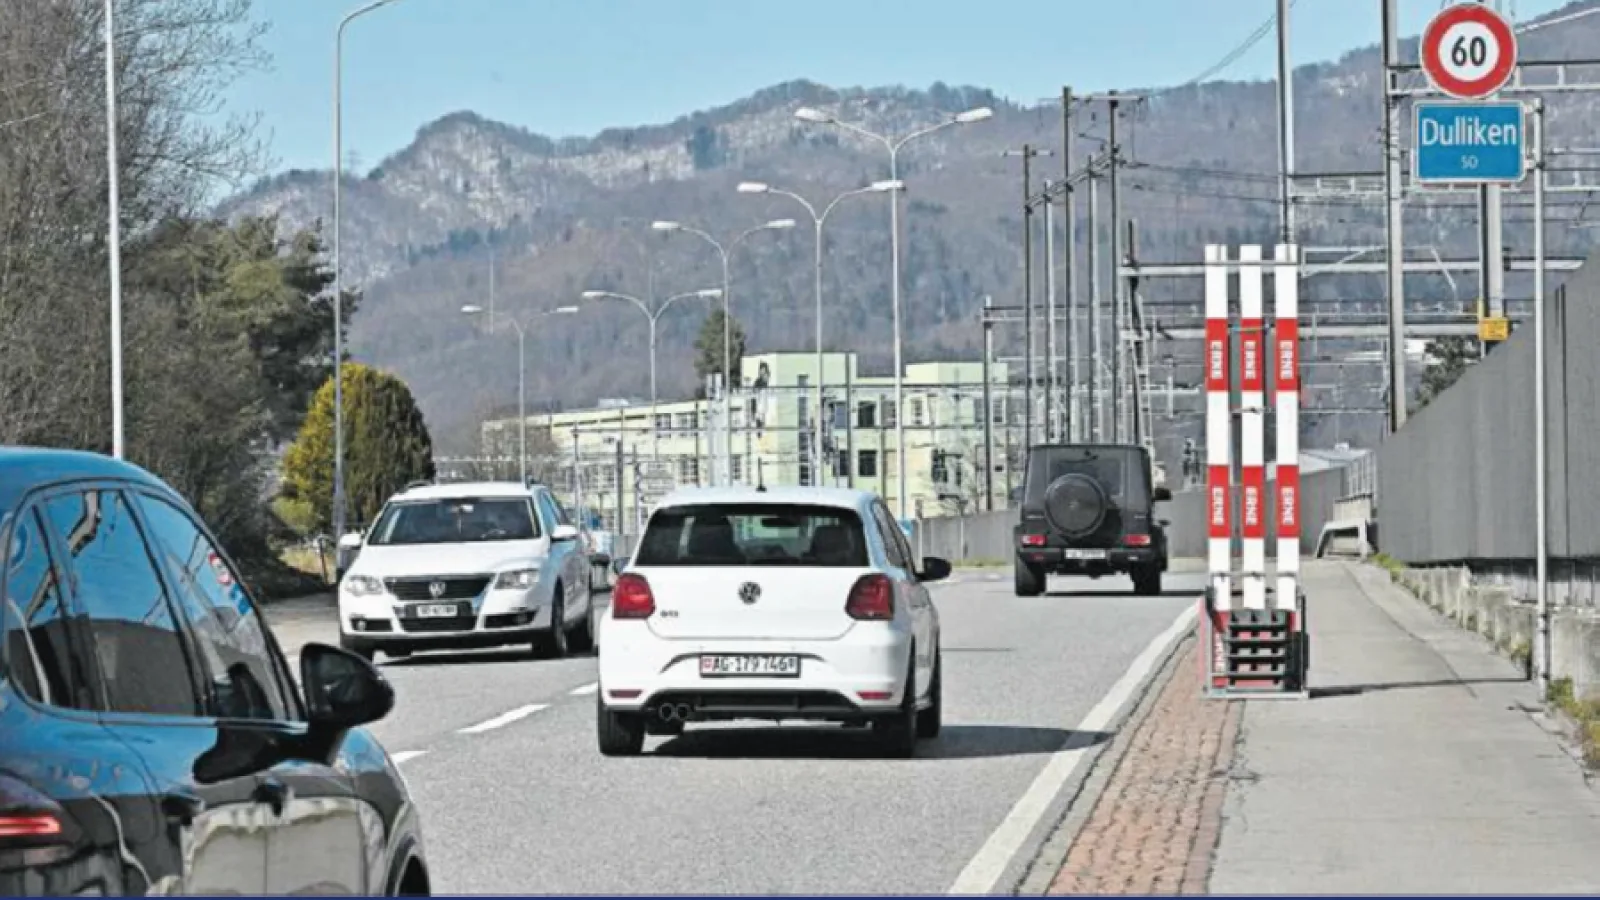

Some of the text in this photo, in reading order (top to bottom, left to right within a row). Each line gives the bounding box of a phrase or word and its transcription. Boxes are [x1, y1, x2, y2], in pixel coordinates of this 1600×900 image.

[1451, 35, 1487, 67] 60
[1421, 116, 1517, 146] Dulliken
[1244, 341, 1256, 379] ERNE
[1280, 341, 1293, 379] ERNE
[1212, 487, 1224, 525] ERNE
[1245, 487, 1258, 525] ERNE
[1281, 487, 1294, 525] ERNE
